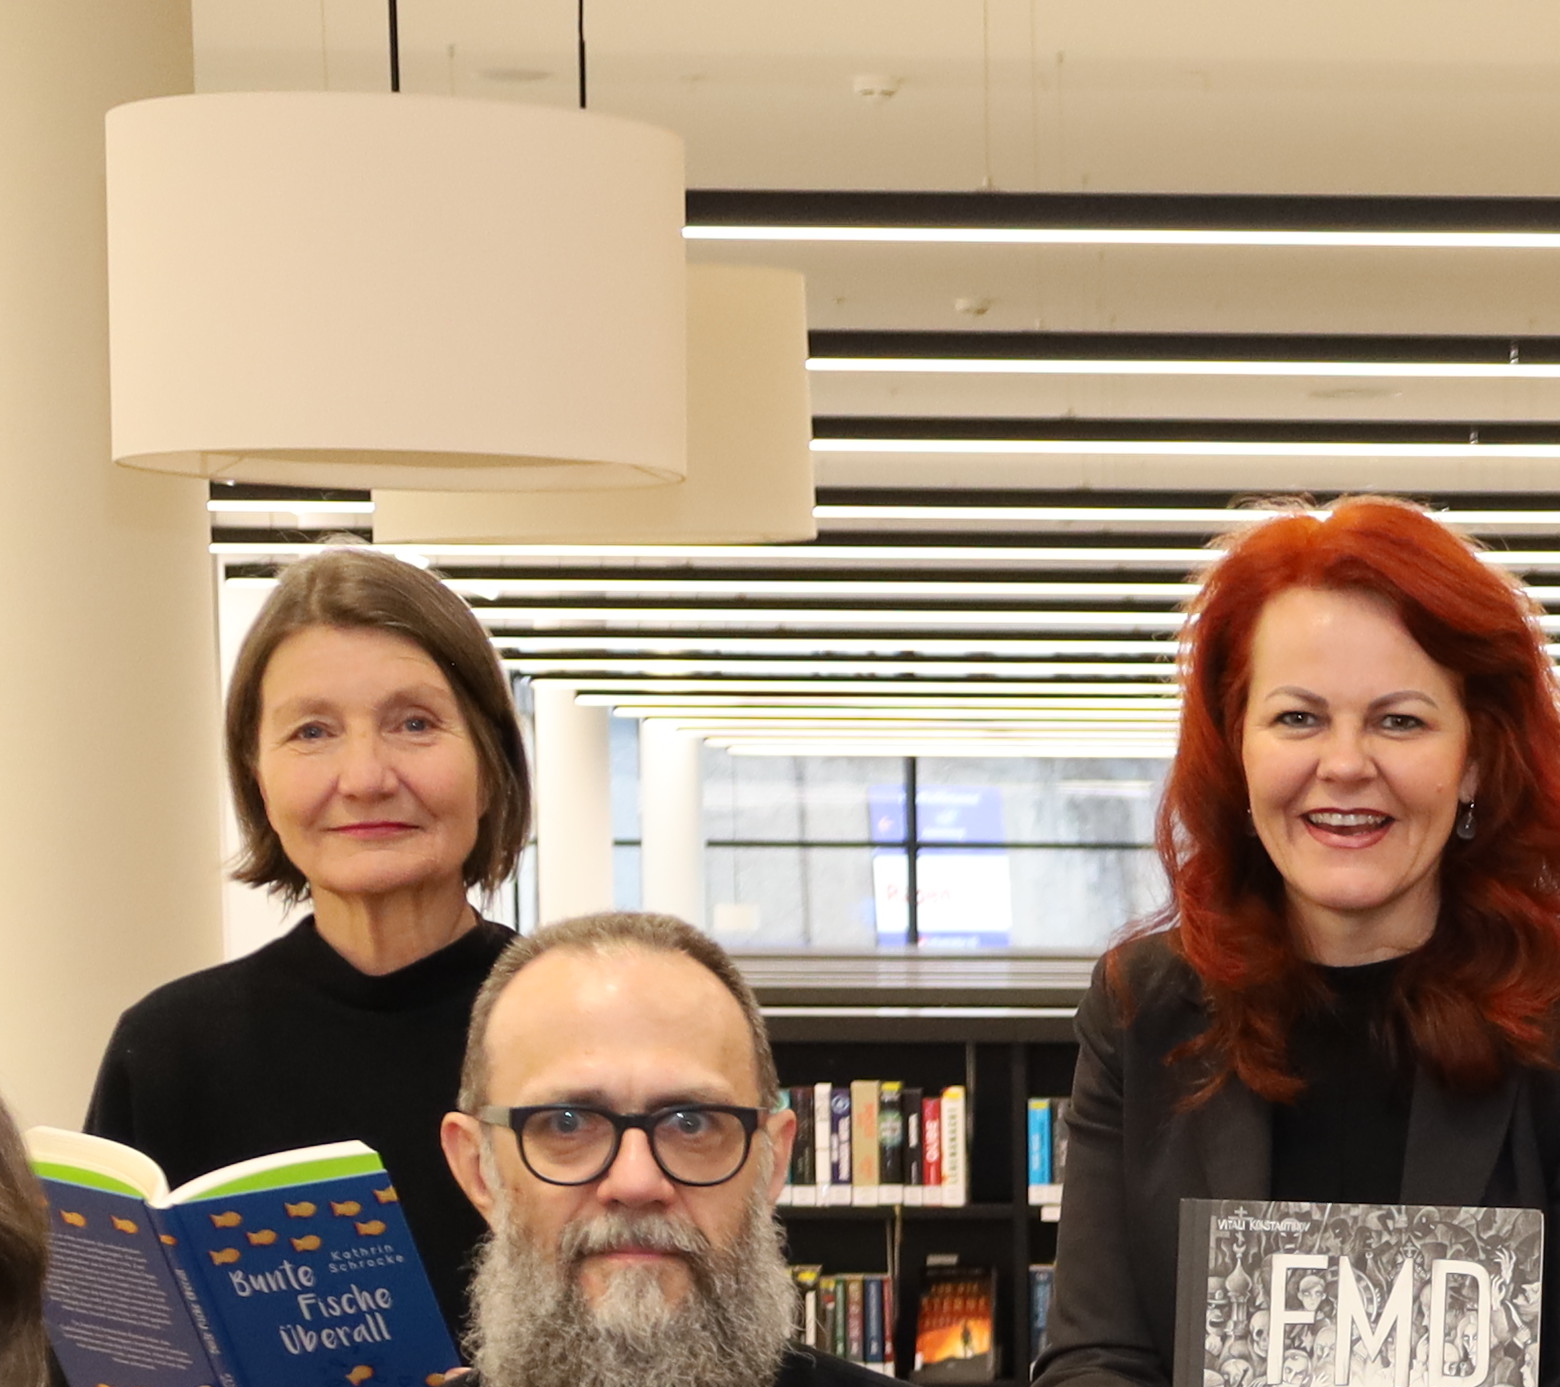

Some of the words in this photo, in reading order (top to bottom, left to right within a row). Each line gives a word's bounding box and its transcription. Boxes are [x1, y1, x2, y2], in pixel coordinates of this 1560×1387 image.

[1217, 1219, 1246, 1230] VITALI
[330, 1244, 394, 1261] Kathrin
[328, 1254, 405, 1273] Schrocke
[229, 1261, 315, 1297] Bunte
[299, 1284, 392, 1321] Fische
